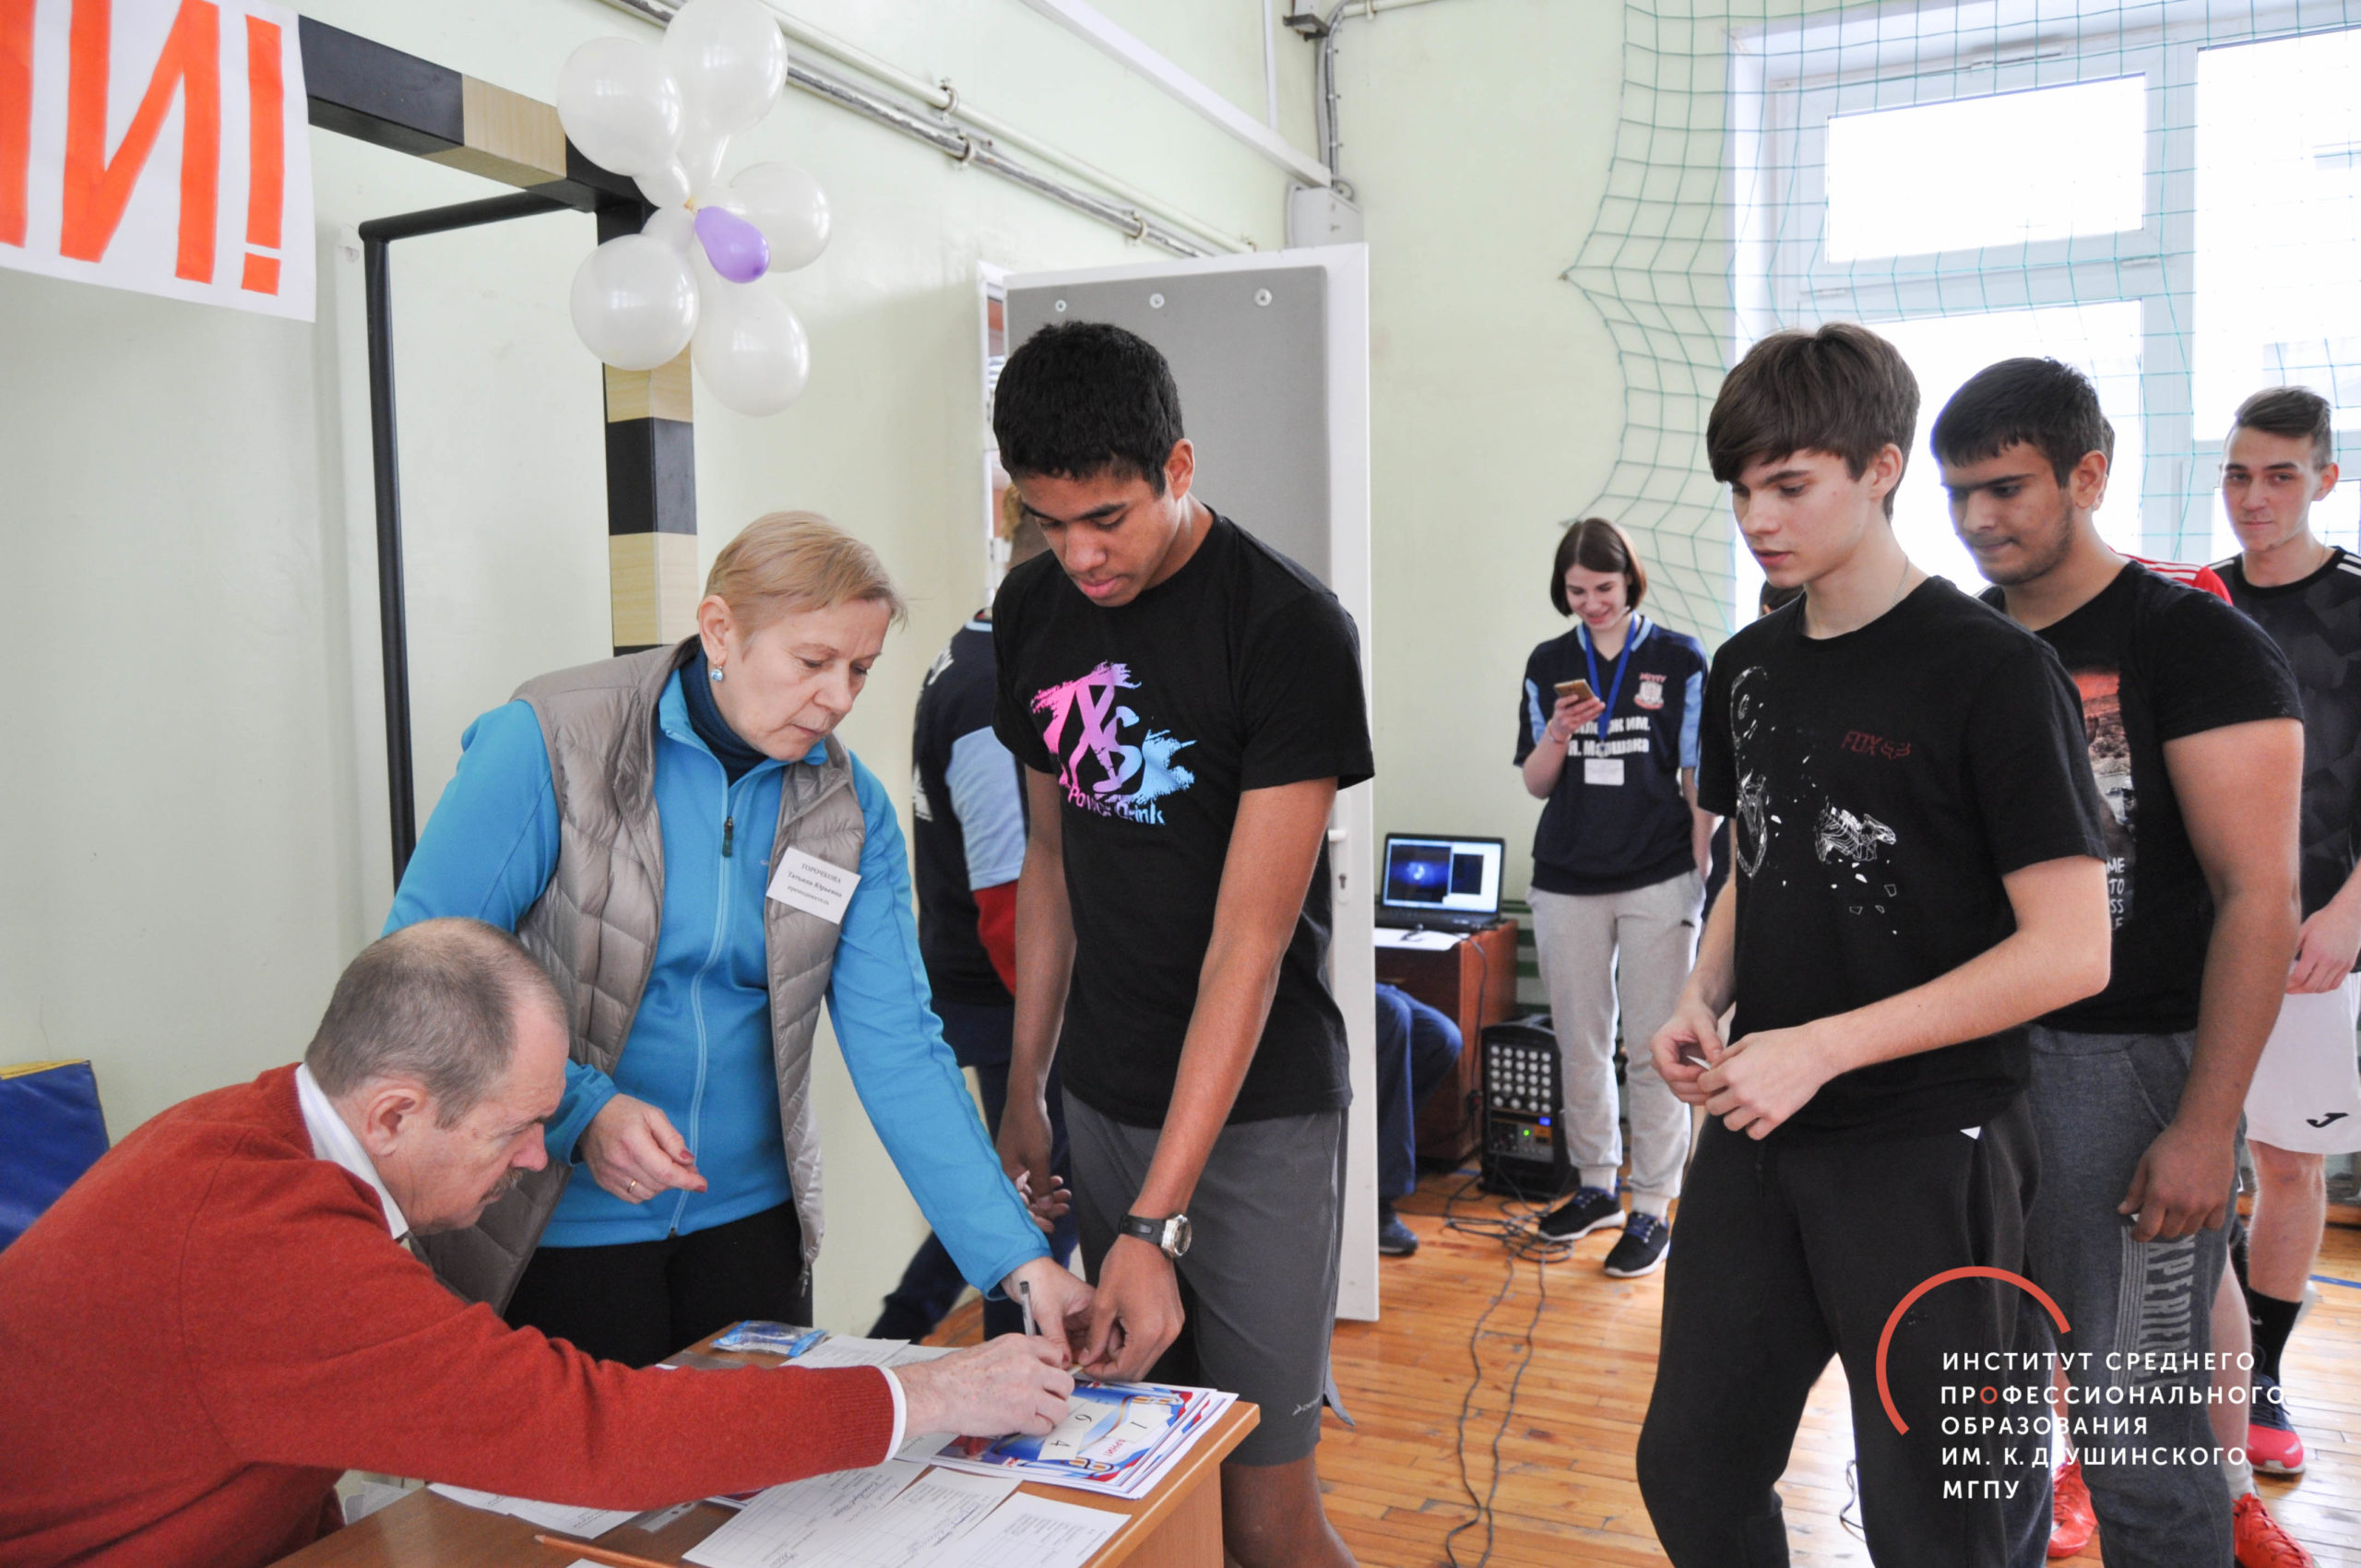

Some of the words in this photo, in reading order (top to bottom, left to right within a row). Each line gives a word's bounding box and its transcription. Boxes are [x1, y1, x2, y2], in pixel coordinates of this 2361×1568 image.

[0, 0, 284, 296] И!
[1841, 731, 1881, 755] FOX
[2109, 898, 2124, 914] SS
